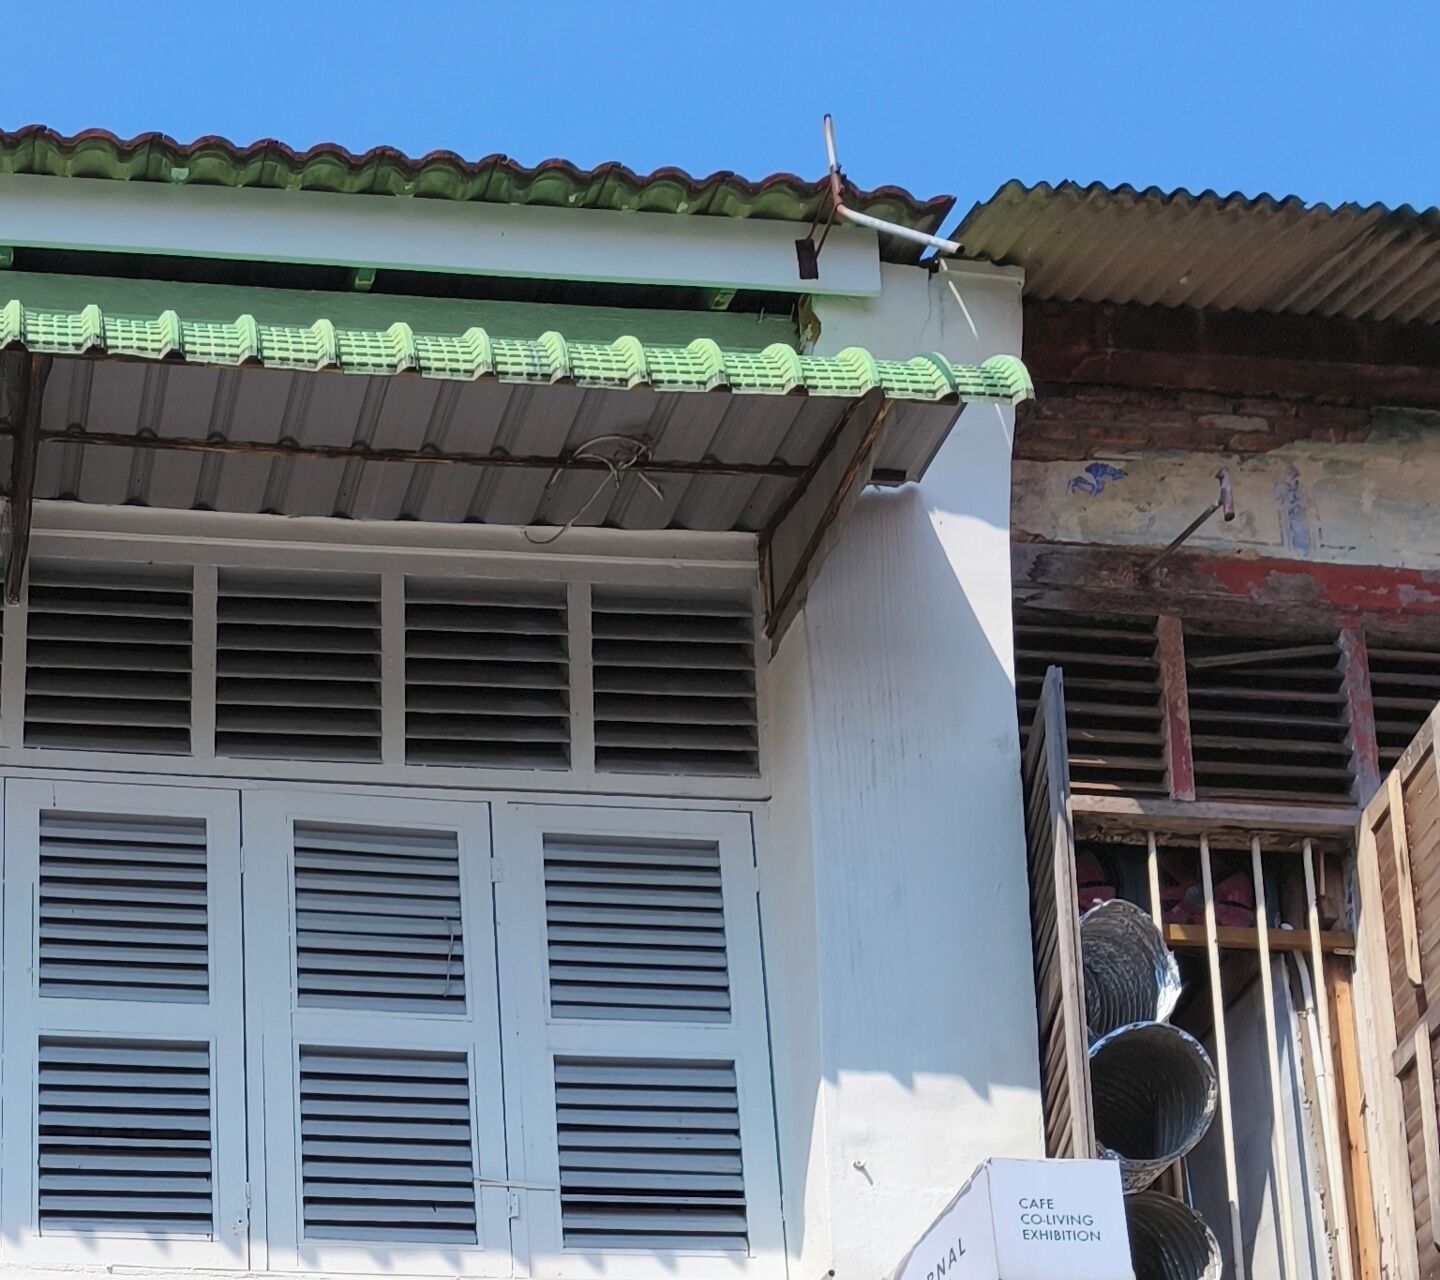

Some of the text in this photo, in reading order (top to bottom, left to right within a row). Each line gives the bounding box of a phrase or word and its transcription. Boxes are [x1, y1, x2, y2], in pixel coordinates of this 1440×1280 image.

[1018, 1197, 1055, 1210] CAFE
[1020, 1213, 1095, 1227] CO-LIVING
[1022, 1228, 1102, 1242] EXHIBITION
